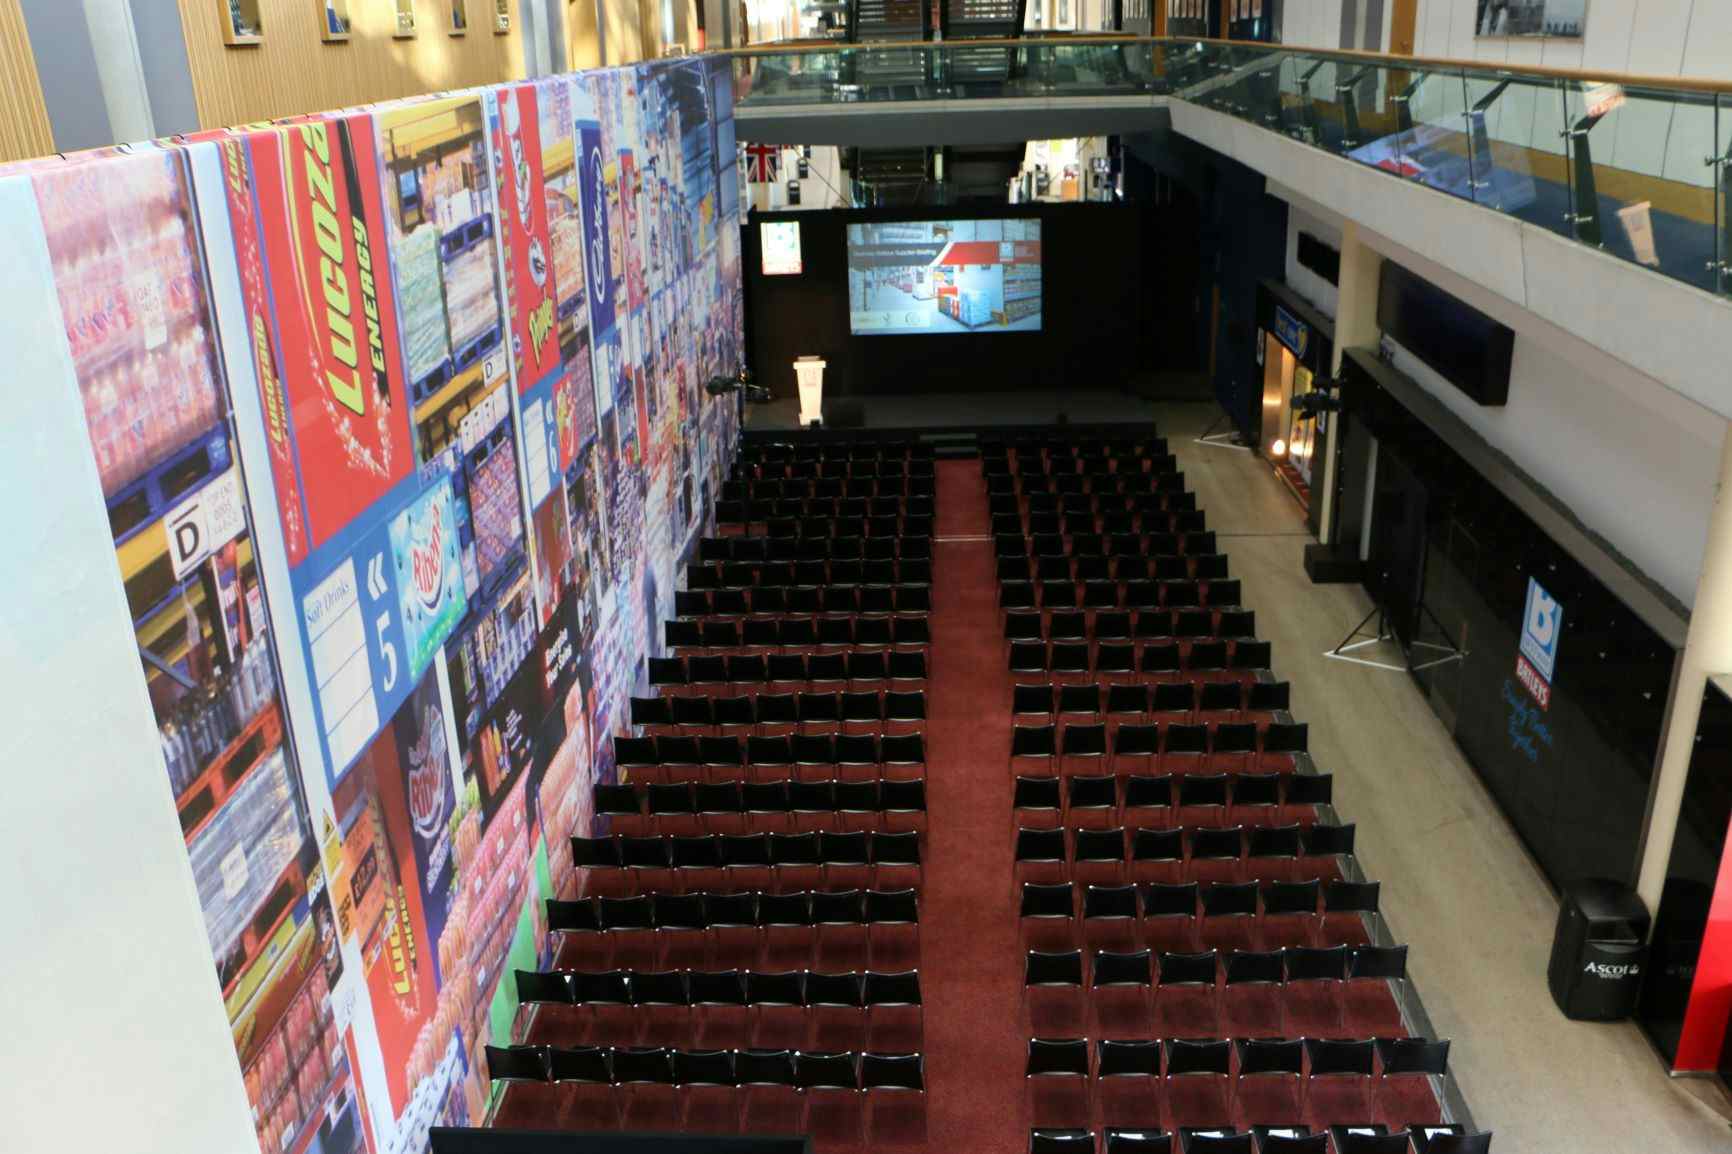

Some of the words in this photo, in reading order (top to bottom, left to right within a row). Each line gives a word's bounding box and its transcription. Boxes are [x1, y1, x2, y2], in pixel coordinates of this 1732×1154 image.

[352, 216, 386, 374] ENERGY
[175, 521, 200, 562] D
[376, 609, 398, 692] 5
